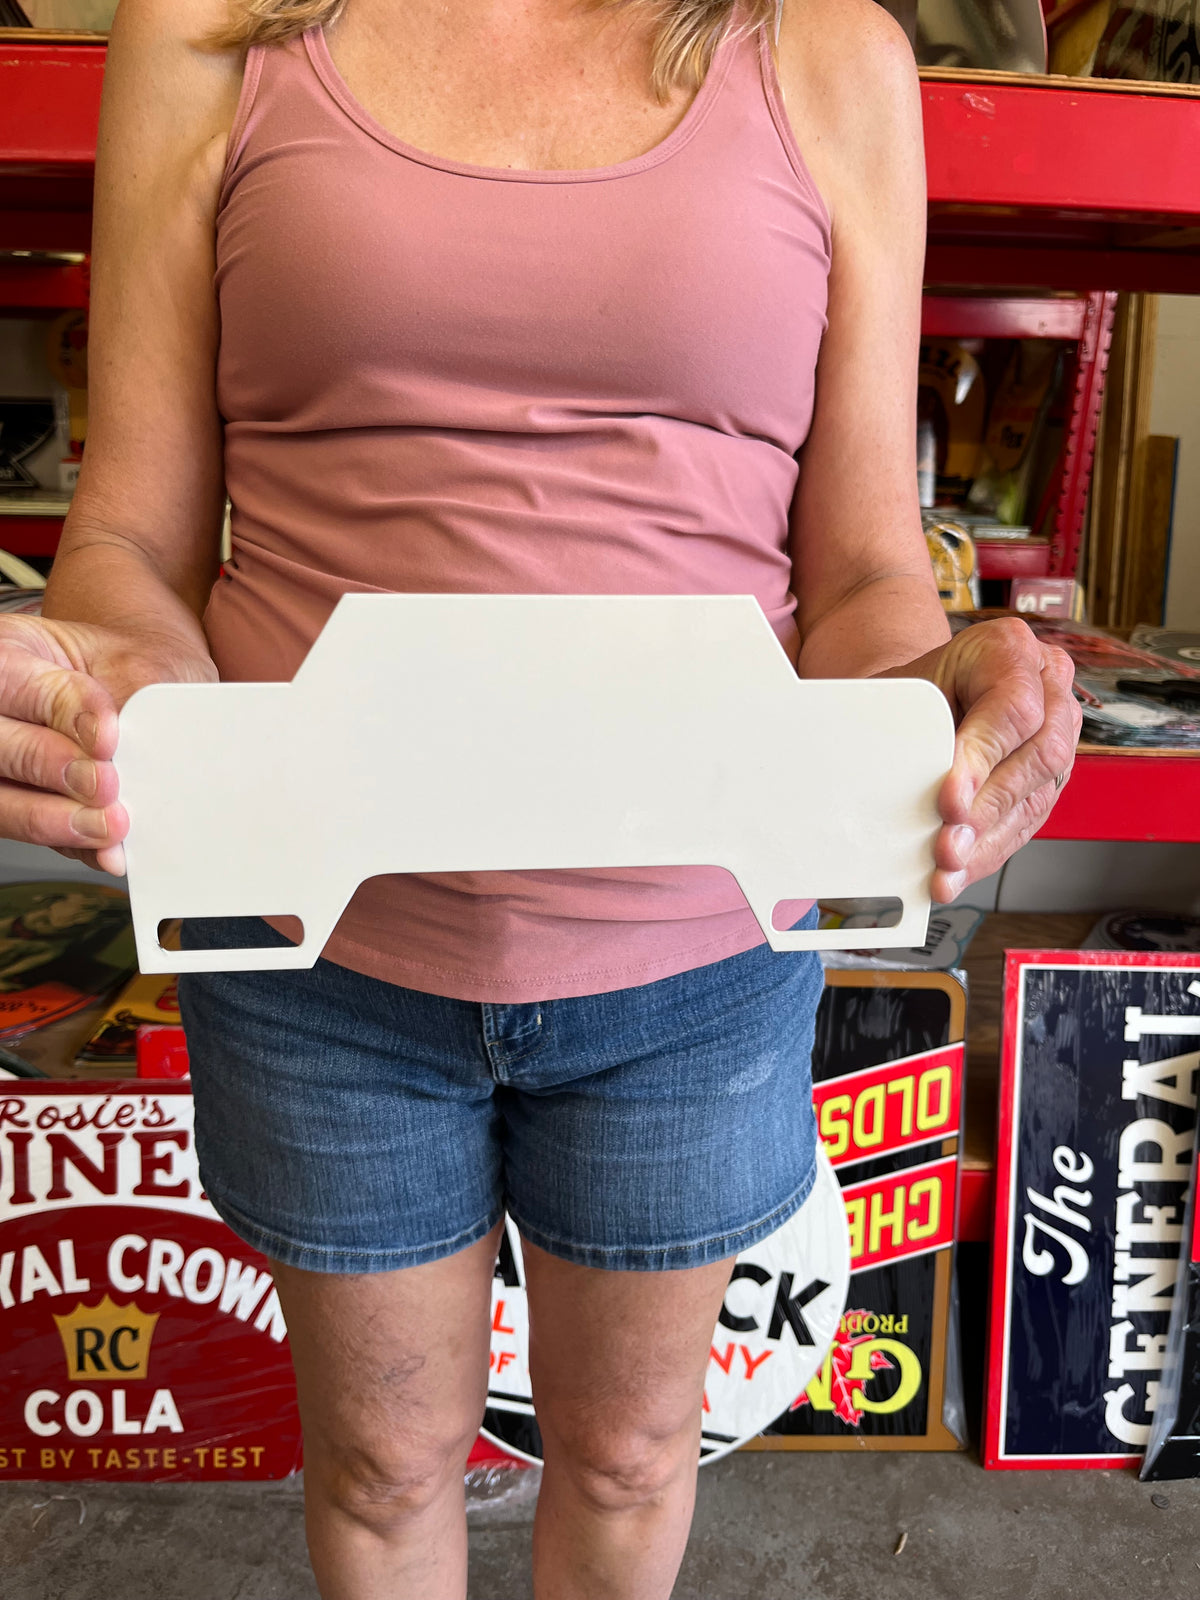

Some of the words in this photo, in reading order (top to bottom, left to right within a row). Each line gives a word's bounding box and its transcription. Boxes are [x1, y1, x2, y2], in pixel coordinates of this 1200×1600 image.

[0, 1095, 177, 1130] Rosie's
[813, 1065, 951, 1158] OLDS
[0, 1129, 209, 1205] INE
[1023, 1145, 1094, 1286] The
[1103, 980, 1200, 1446] GENERAL
[75, 1326, 140, 1372] RC
[24, 1389, 184, 1437] COLA
[40, 1448, 75, 1469] BY
[88, 1446, 266, 1469] TASTE-TEST
